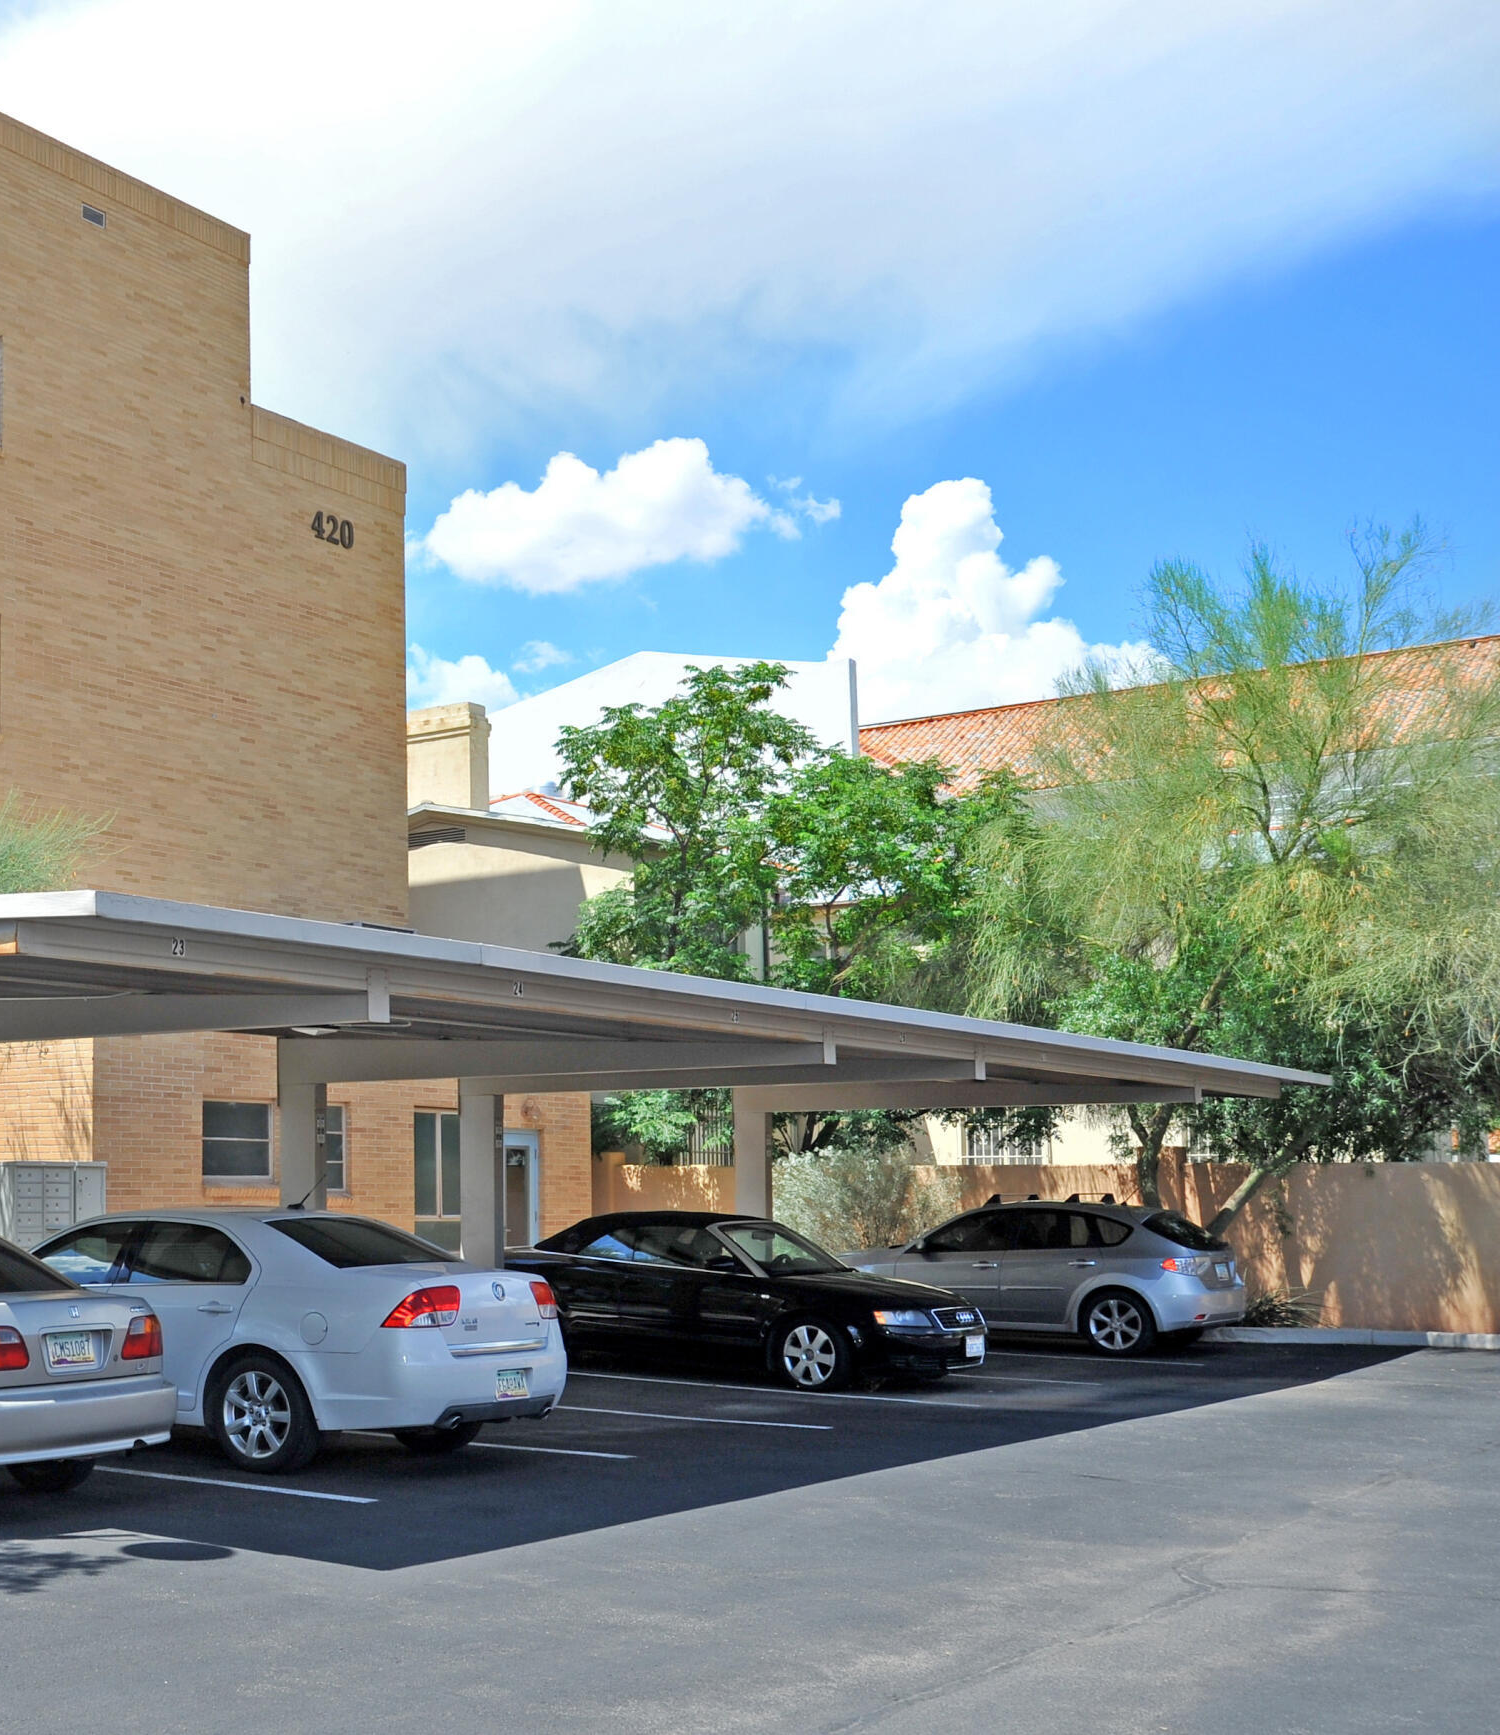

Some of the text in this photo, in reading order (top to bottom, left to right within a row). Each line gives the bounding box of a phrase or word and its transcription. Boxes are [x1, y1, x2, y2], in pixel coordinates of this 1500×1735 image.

[311, 510, 354, 550] 420
[172, 937, 185, 956] 23
[513, 981, 523, 997] 24
[53, 1339, 91, 1358] CMS1087
